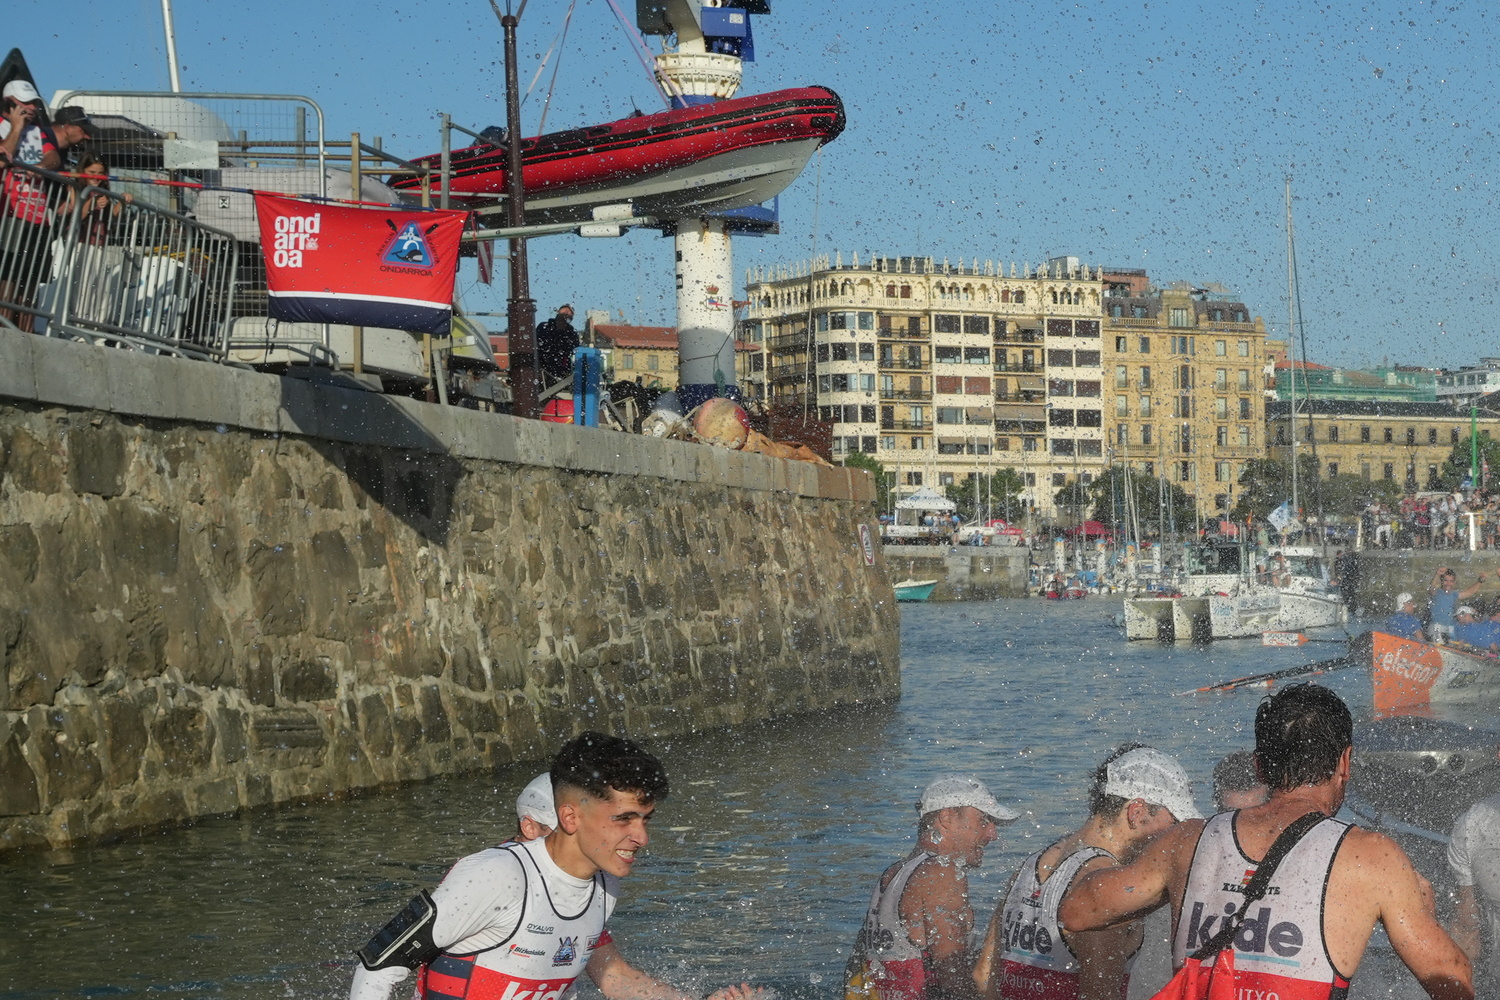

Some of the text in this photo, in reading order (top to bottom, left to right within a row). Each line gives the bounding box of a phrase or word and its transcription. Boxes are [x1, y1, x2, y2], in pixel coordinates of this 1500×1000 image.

[274, 213, 321, 234] ond
[273, 231, 308, 251] arr
[273, 250, 302, 268] oa
[379, 265, 433, 277] ONDARROA
[1185, 901, 1304, 957] kide
